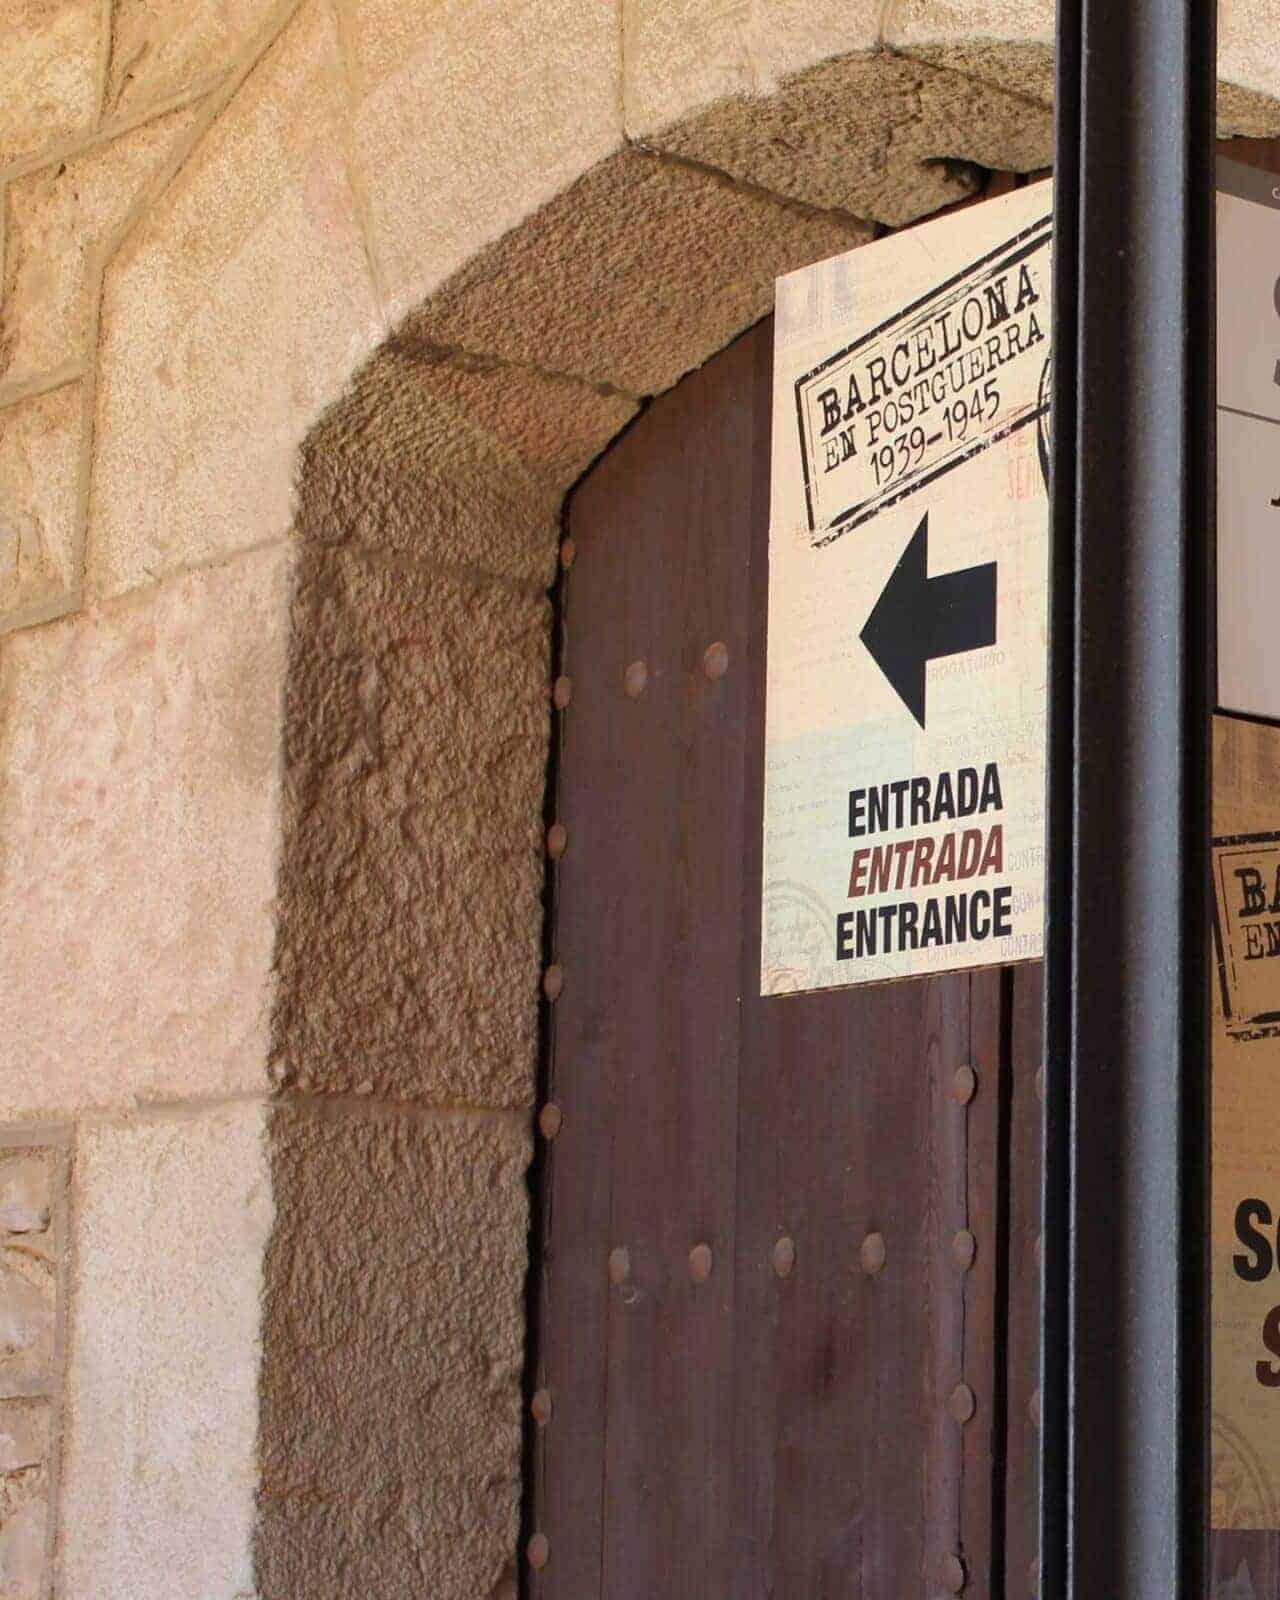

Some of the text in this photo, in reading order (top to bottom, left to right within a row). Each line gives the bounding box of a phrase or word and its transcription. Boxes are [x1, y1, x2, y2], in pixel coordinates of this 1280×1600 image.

[816, 264, 1040, 437] BARCELONA
[824, 312, 1046, 474] EN POSTGUERRA
[848, 762, 1004, 838] ENTRADA
[847, 824, 1004, 898] ENTRADA
[836, 886, 1013, 961] ENTRANCE
